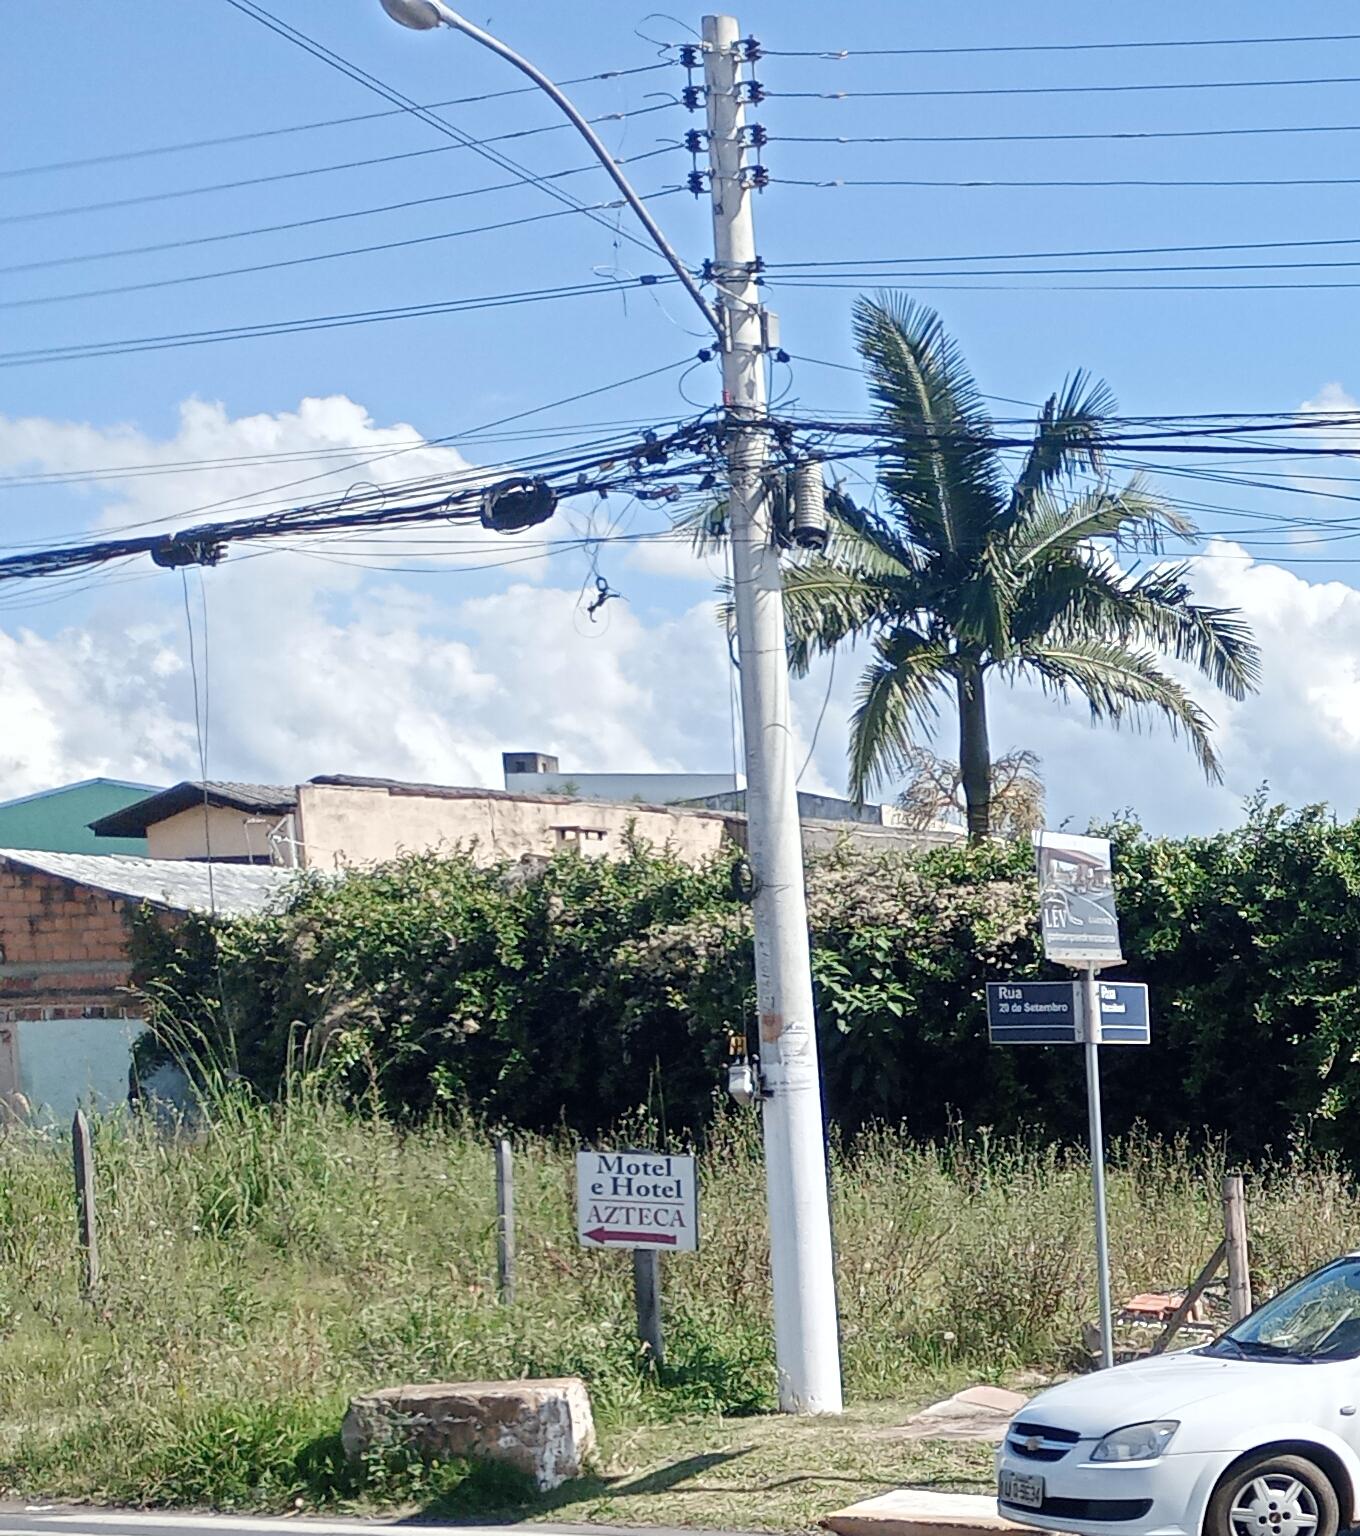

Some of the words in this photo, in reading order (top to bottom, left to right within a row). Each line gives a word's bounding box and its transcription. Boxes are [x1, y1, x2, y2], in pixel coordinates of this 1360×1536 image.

[998, 986, 1023, 999] Rua
[1011, 1002, 1022, 1013] de
[597, 1155, 674, 1177] Motel
[591, 1182, 603, 1195] e
[612, 1176, 683, 1199] Hotel
[587, 1204, 687, 1228] AZTECA
